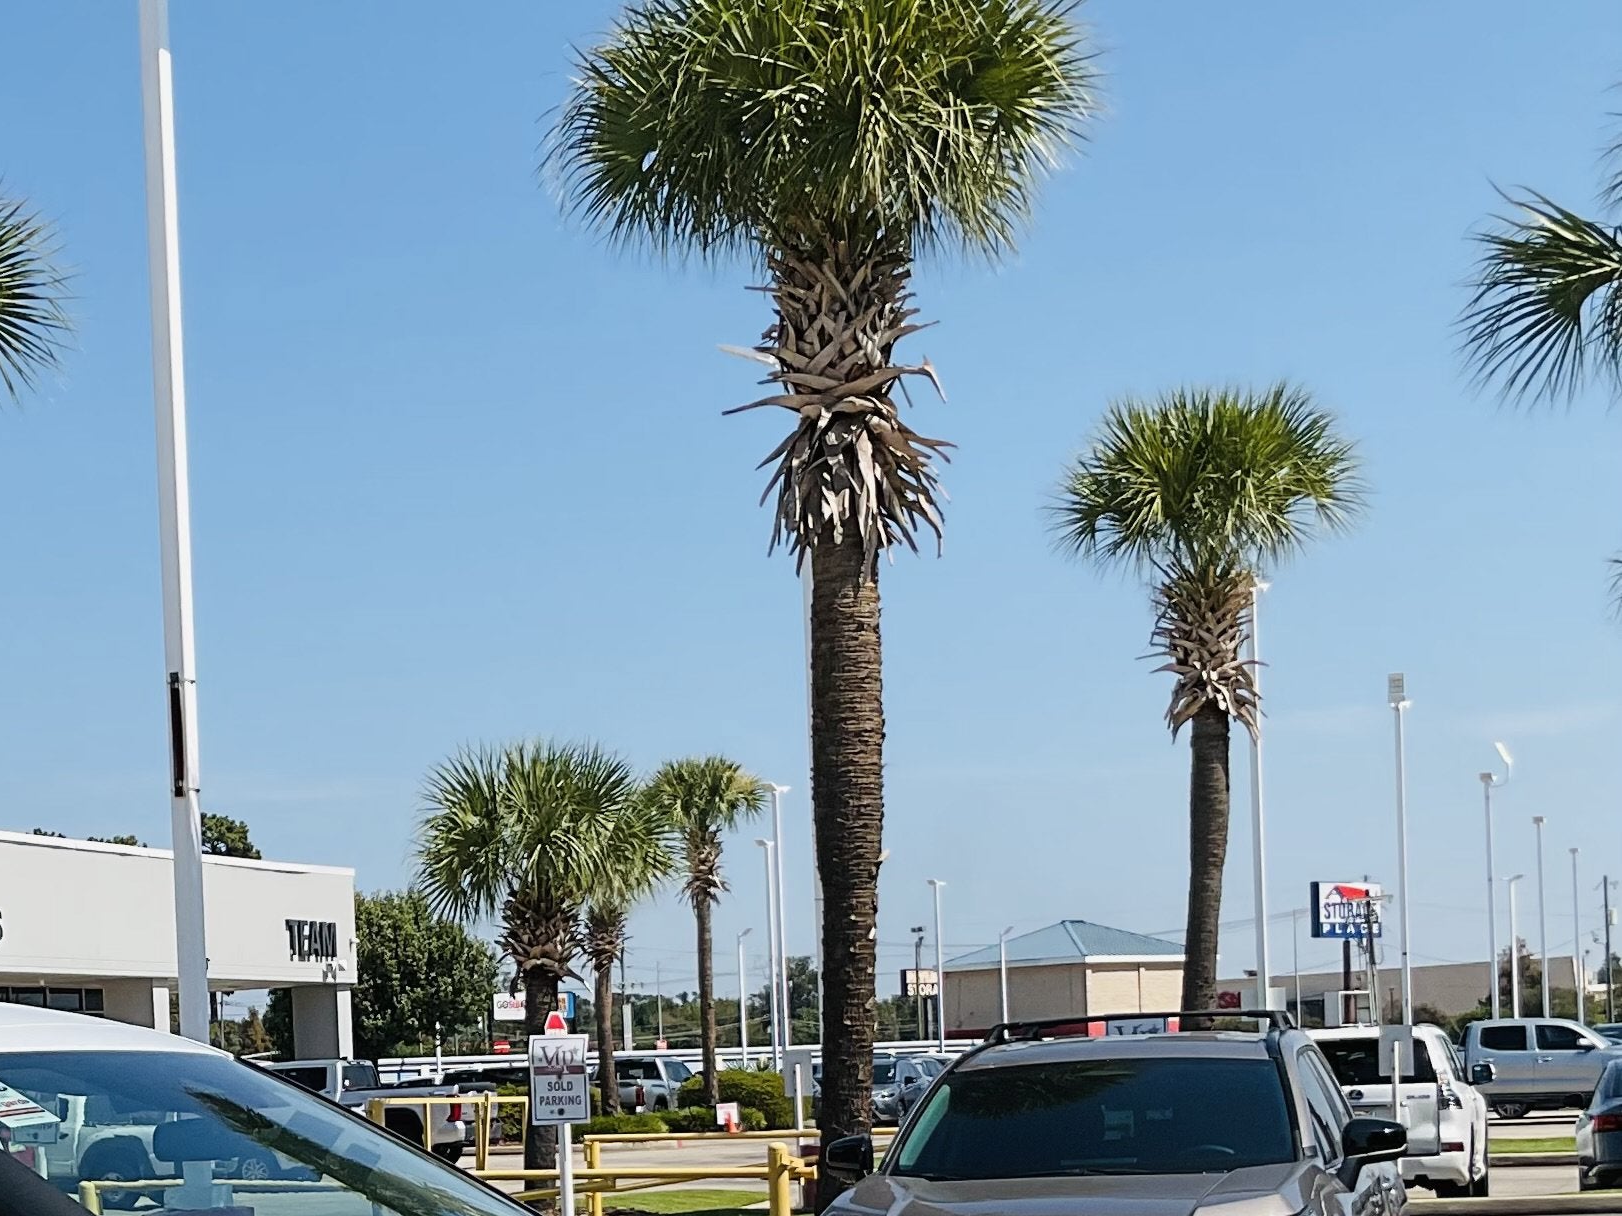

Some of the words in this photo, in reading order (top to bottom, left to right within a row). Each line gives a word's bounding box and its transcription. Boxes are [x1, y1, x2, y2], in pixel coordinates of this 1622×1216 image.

[1323, 902, 1379, 921] STORA
[1322, 922, 1380, 934] PLACE
[284, 919, 337, 958] TEAM
[547, 1081, 573, 1092] SOLD
[539, 1095, 582, 1106] PARKING
